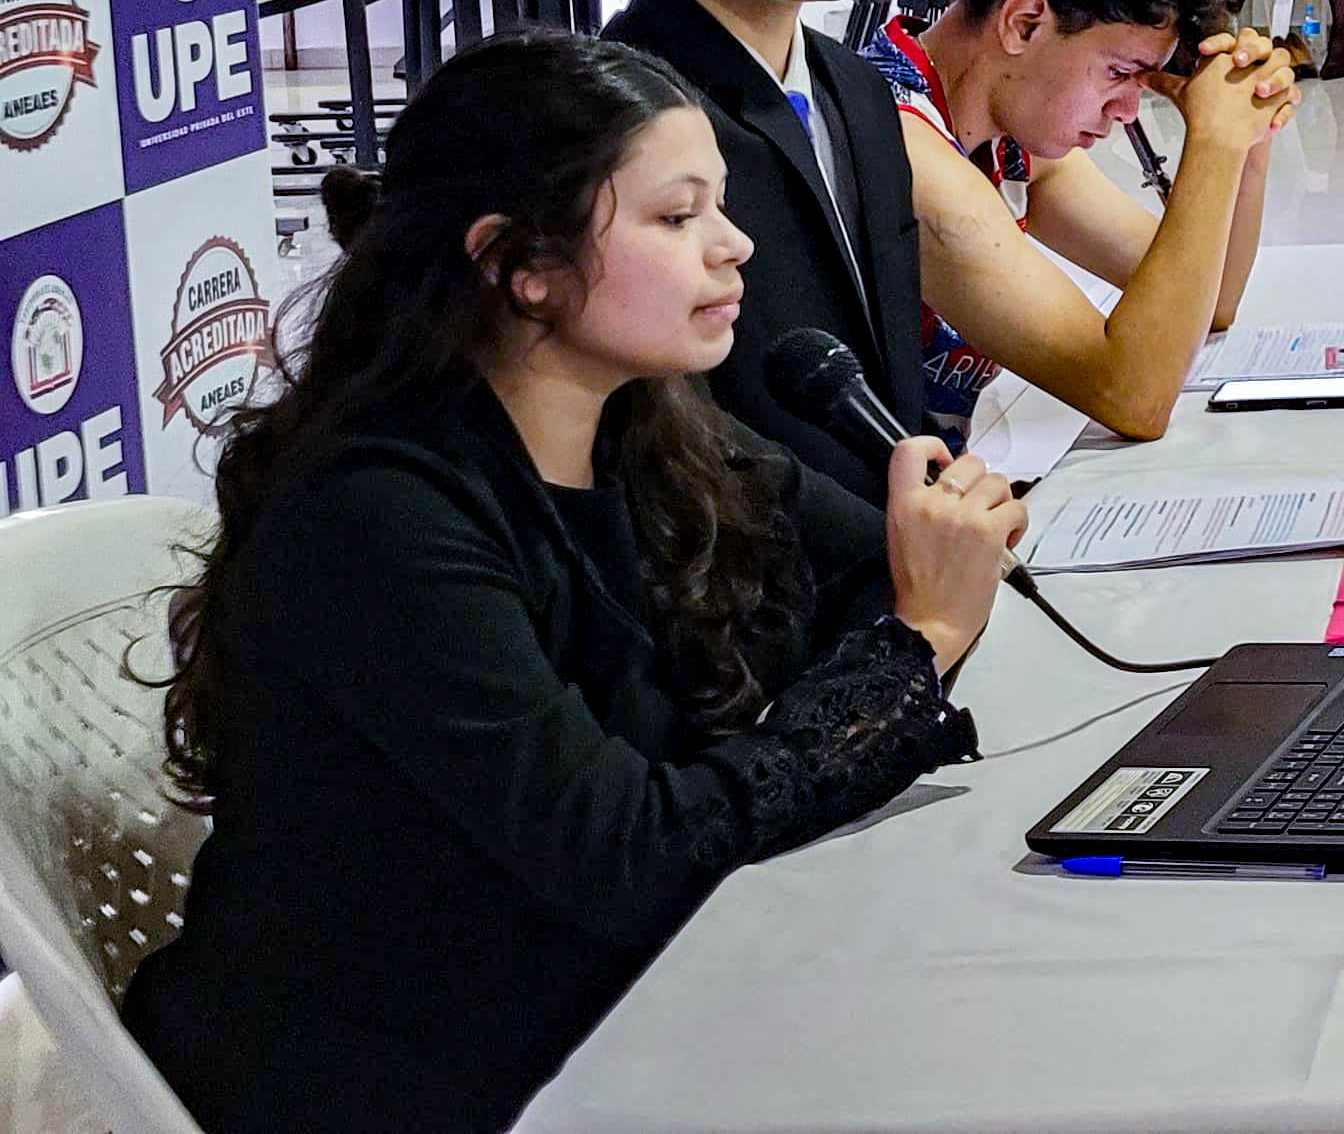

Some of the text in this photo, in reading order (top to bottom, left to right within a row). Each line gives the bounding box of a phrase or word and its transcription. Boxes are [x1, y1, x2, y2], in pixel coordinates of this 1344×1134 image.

[131, 9, 252, 123] UPE
[3, 89, 58, 120] ANEAES
[188, 267, 241, 312] CARRERA
[170, 310, 266, 385] ACREDITADA
[200, 377, 245, 413] ANEAES
